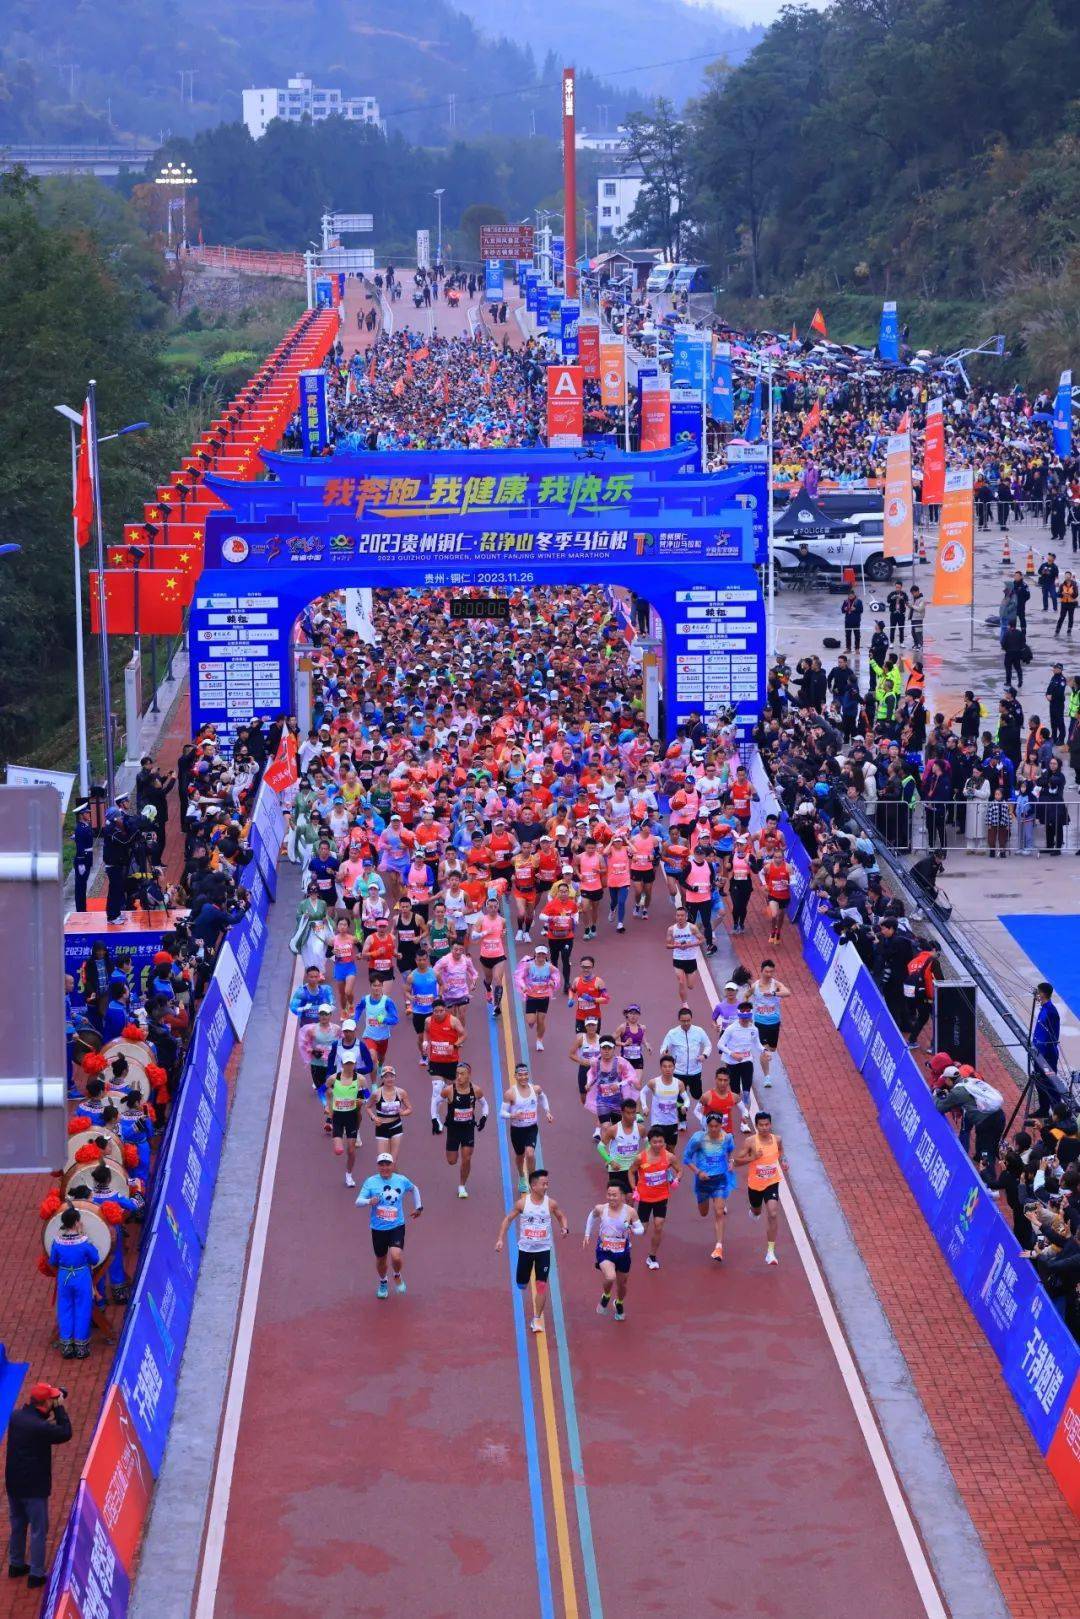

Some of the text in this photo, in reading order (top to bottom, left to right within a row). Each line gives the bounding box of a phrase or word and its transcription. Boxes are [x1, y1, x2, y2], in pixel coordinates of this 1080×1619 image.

[554, 372, 577, 395] A
[323, 474, 635, 520] 我奔跑 我健康 我快乐
[568, 551, 610, 559] MARATHON
[477, 572, 534, 583] 2023.11.26
[1021, 1325, 1065, 1416] 干净跑道
